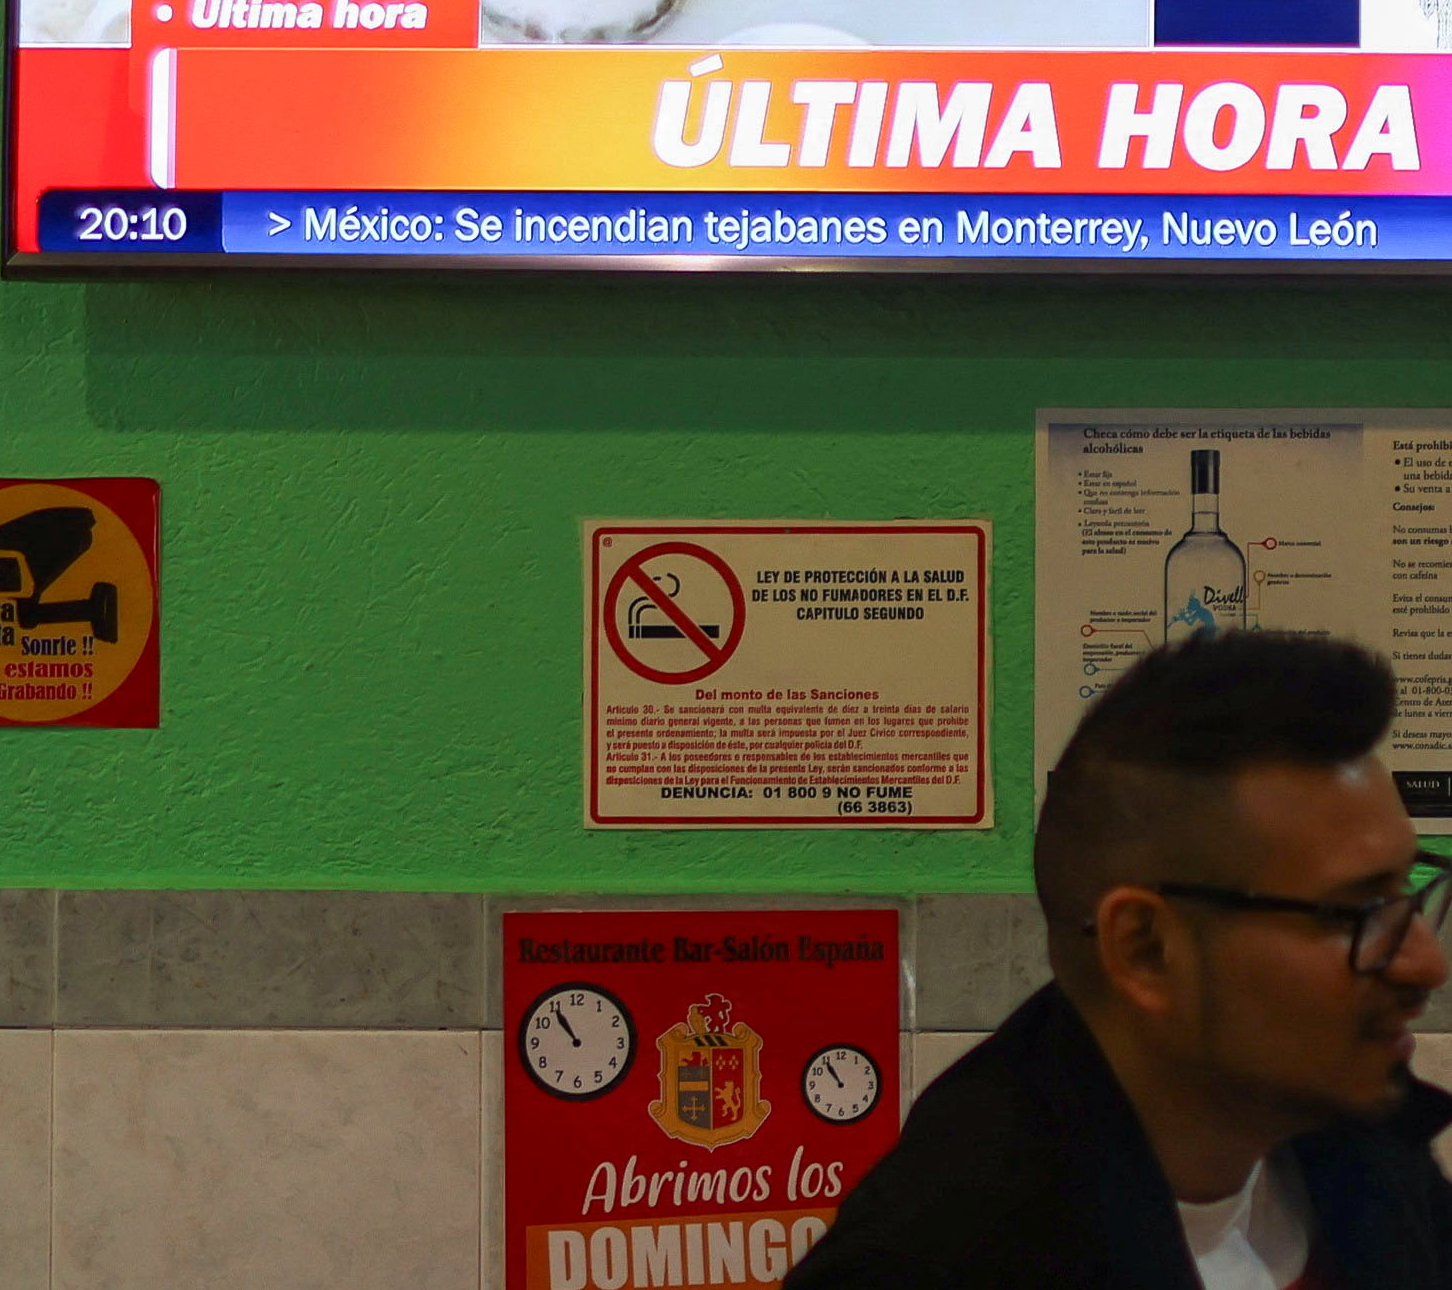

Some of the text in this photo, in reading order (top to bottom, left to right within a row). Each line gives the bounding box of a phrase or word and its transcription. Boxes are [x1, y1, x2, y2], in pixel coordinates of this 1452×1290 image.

[654, 53, 1421, 169] ÚLTIMA HORA
[80, 208, 186, 240] 20:10
[303, 208, 1378, 252] México: Se incendian tejabanes en Monterrey, Nuevo León
[1083, 428, 1331, 442] Checa cómo debe ser la etiqueta de las bebidas
[1083, 443, 1143, 454] alcohólicas
[1392, 440, 1414, 451] Está
[1403, 456, 1414, 468] El
[1415, 459, 1433, 468] uso
[1433, 456, 1447, 468] de
[1403, 473, 1421, 481] una
[1403, 483, 1416, 494] Su
[1417, 486, 1443, 494] venta
[1392, 501, 1435, 514] Consejos:
[1409, 538, 1422, 546] un
[1423, 536, 1450, 548] riesgo
[757, 568, 964, 583] LEY DE PROTECCIÓN A LA SALUD
[752, 589, 969, 602] DE LOS NO FUMADORES EN EL D.F.
[797, 607, 924, 620] CAPITULO SEGUNDO
[4, 660, 94, 679] estamos
[696, 689, 879, 700] Del monto de las Sanciones
[661, 787, 912, 798] DENUNCIA: 01 800 9 NO FUME
[838, 801, 913, 816] (66 3863)
[518, 933, 885, 970] Restaurante Bar-Salón España
[582, 1145, 843, 1216] Abrimos los
